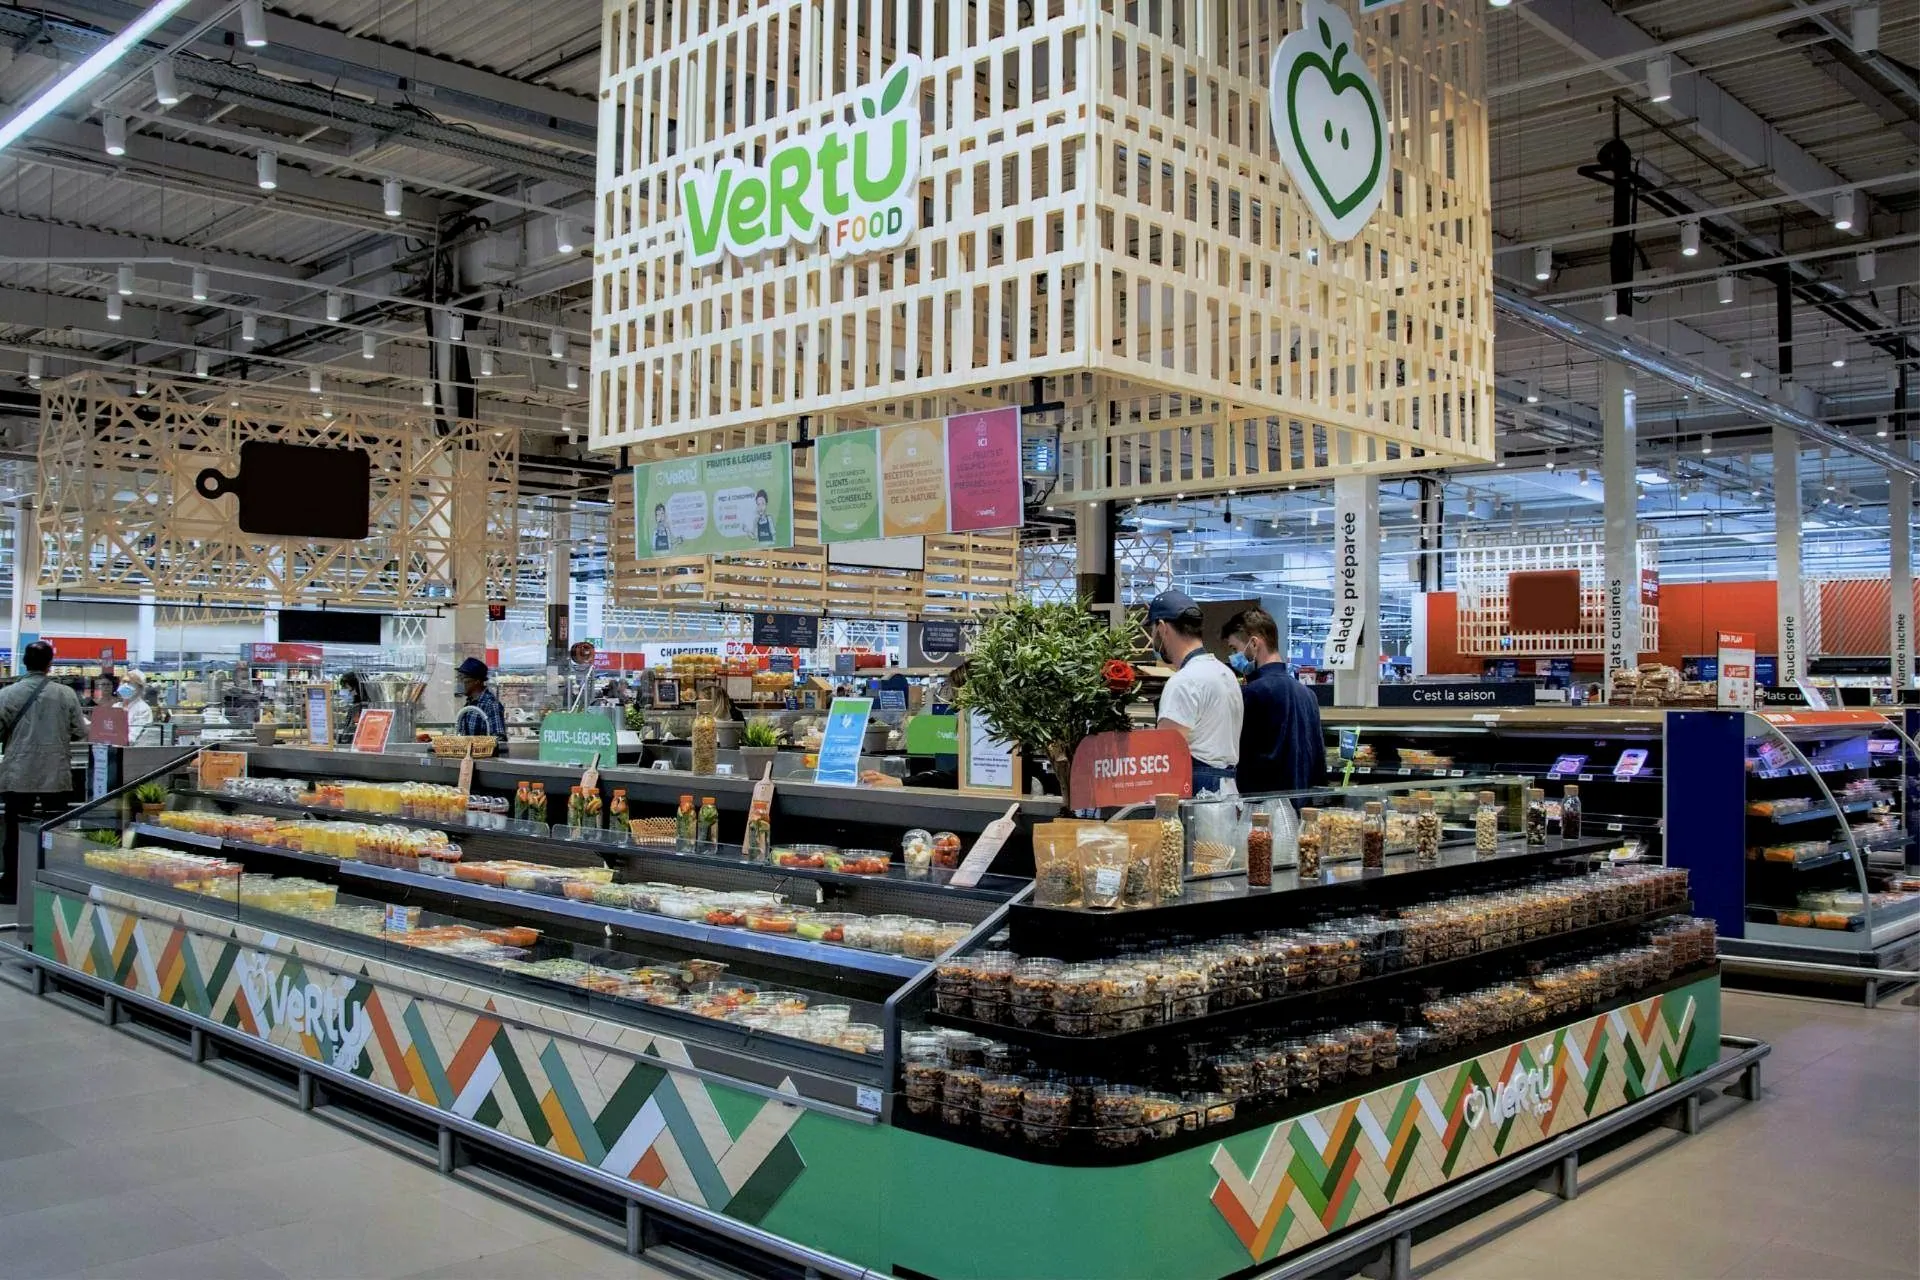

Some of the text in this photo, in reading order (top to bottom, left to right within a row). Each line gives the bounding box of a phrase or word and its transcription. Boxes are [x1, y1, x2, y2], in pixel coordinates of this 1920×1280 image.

[836, 206, 903, 247] FOOD
[706, 457, 731, 469] FRUITS
[737, 450, 773, 464] LÉGUMES
[825, 478, 849, 488] CLIENTS
[1329, 512, 1358, 665] Salade préparée
[1609, 579, 1621, 639] cuisinés
[660, 647, 718, 657] CHARCUTERIE
[1784, 615, 1795, 683] Saucisserie
[1896, 613, 1906, 688] Viande hachée
[1412, 689, 1496, 701] C'est la saison
[1763, 691, 1786, 701] Plats
[543, 727, 611, 746] FRUITS-LÉGUMES
[1094, 754, 1170, 778] FRUITS SECS
